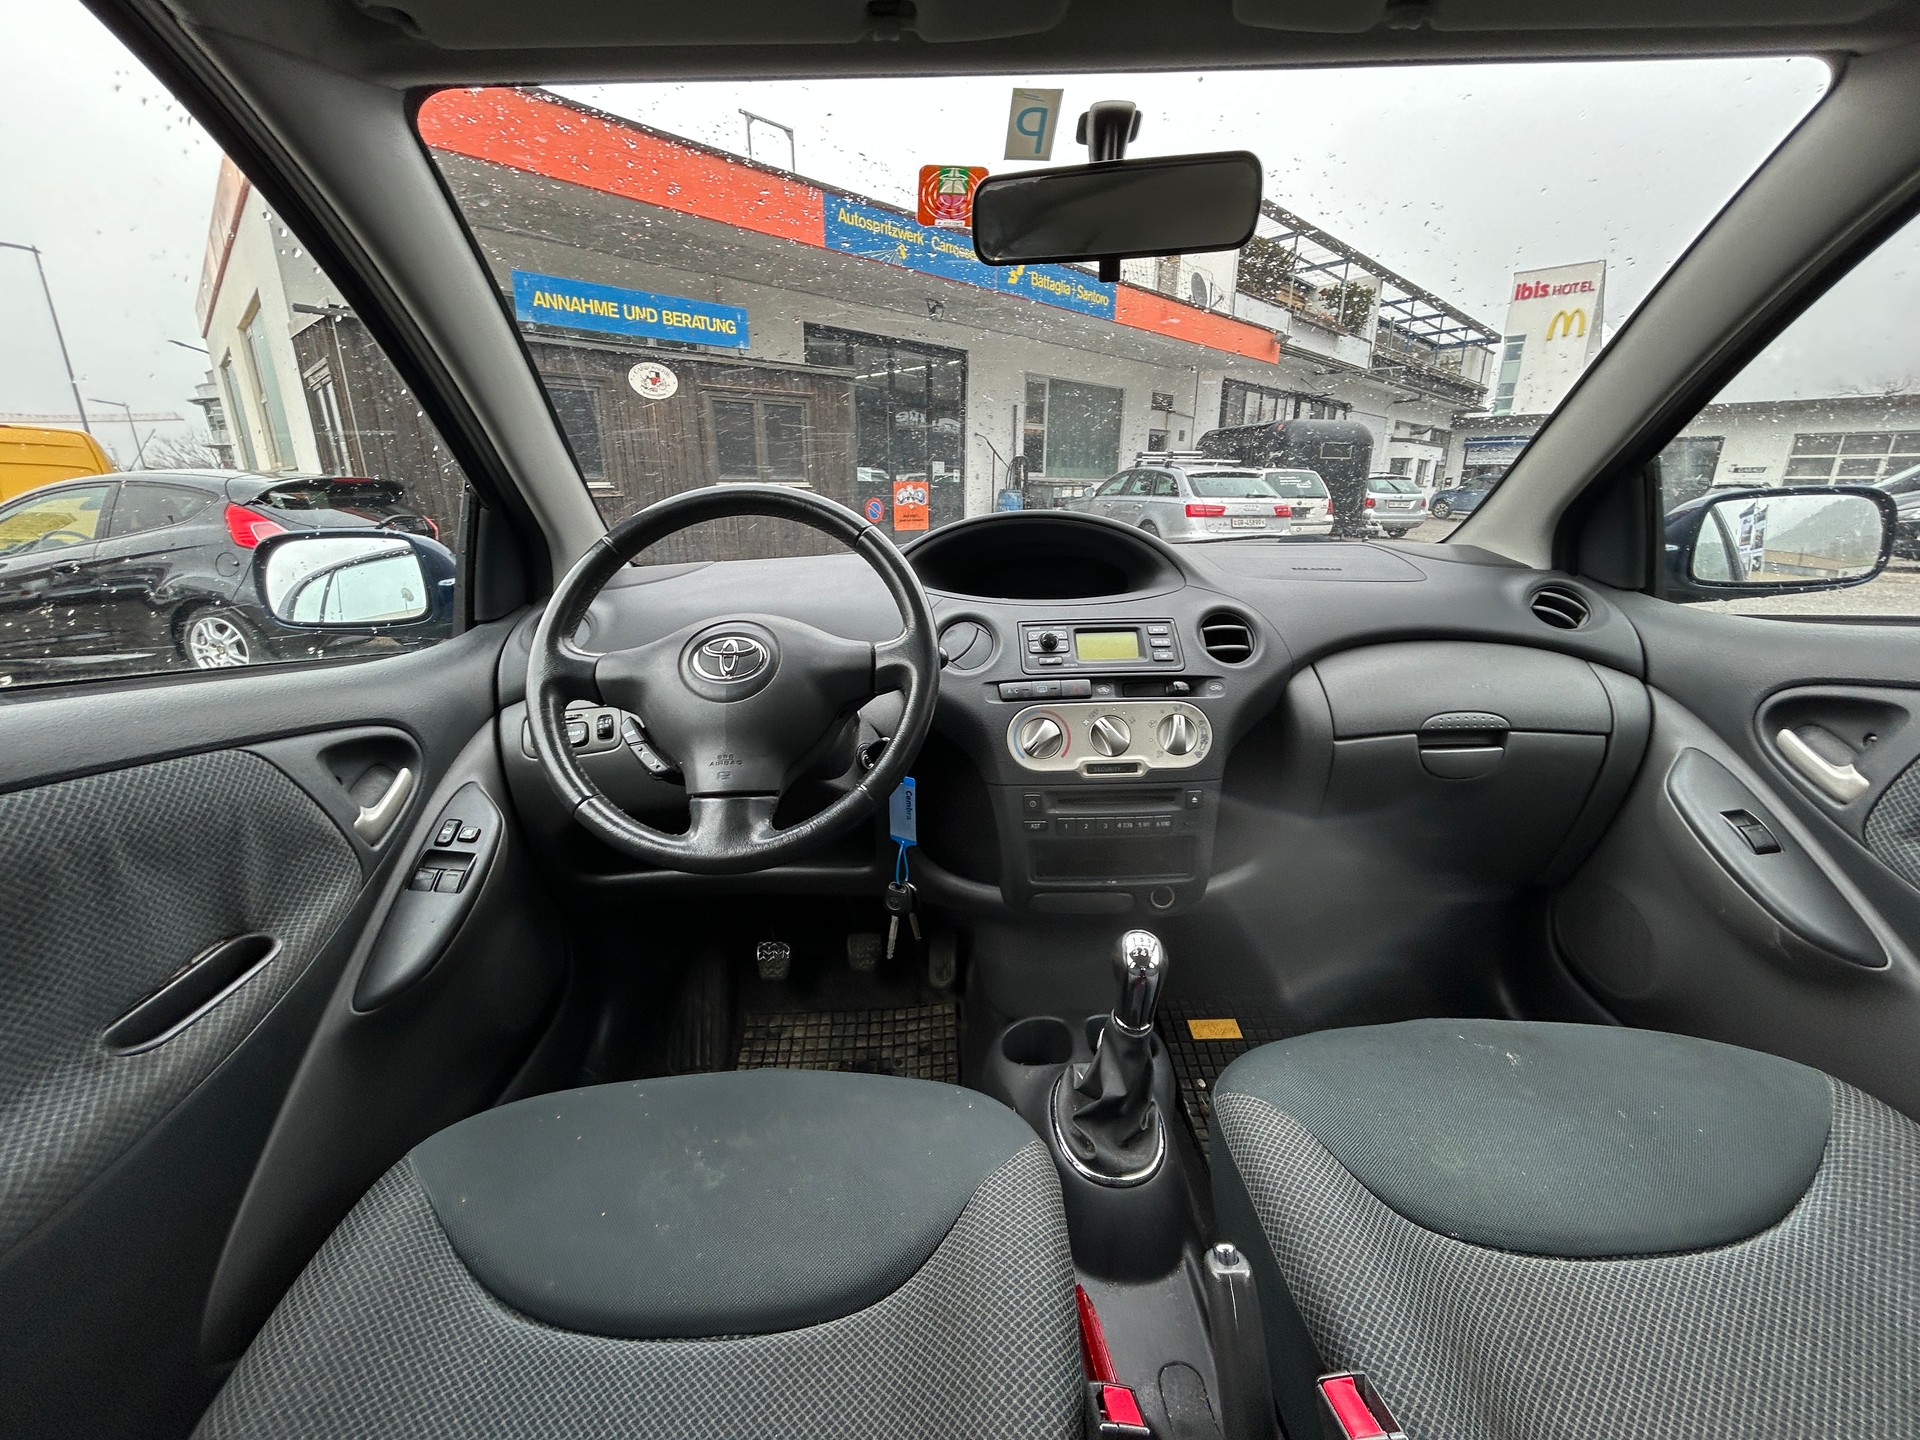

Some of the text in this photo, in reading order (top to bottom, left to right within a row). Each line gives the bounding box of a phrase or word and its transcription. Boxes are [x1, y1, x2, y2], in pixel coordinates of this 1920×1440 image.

[838, 207, 979, 262] Autospritzwerk Carrosse
[1030, 271, 1071, 296] Battaglia
[1077, 285, 1109, 306] Santoro
[1515, 280, 1595, 301] ibis HOTEL
[533, 290, 737, 334] ANNAHME UND BERATUNG
[905, 790, 913, 820] Cembra
